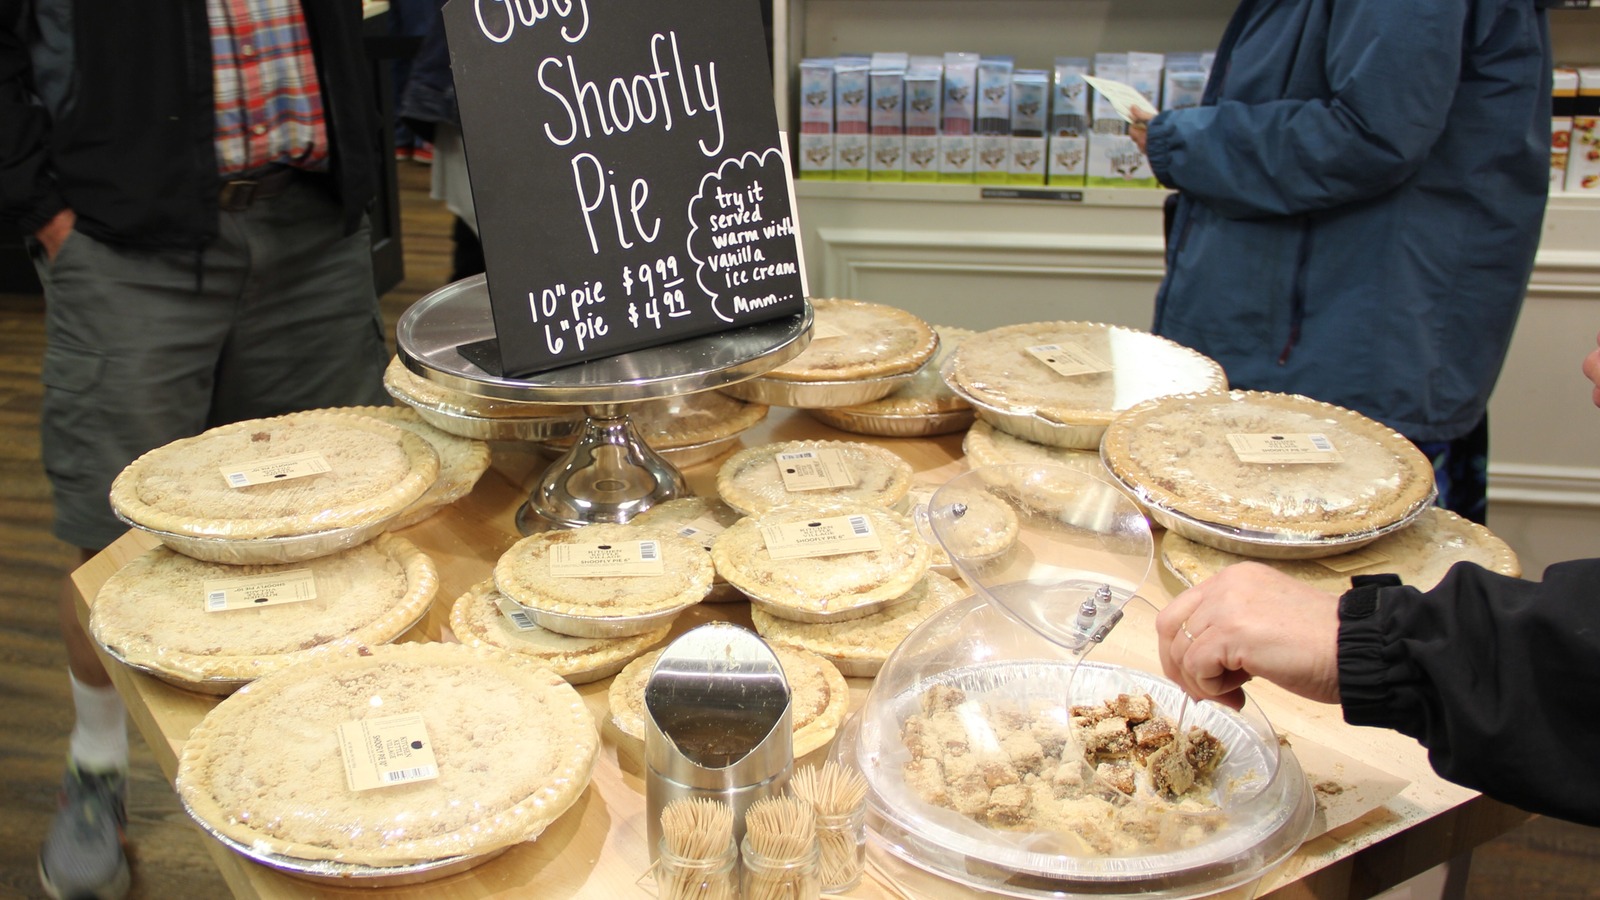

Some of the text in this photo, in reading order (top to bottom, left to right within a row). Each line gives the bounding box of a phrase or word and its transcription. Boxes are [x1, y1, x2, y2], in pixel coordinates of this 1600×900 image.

[538, 31, 724, 156] Shoofly
[572, 153, 661, 254] Pie
[715, 180, 763, 212] try it
[710, 203, 762, 232] served
[712, 216, 795, 249] warm with
[708, 245, 765, 272] vanilla
[725, 262, 796, 288] ice cream
[529, 283, 566, 322] 10"
[571, 281, 605, 321] pie
[544, 319, 570, 354] 6"
[575, 312, 608, 351] pie
